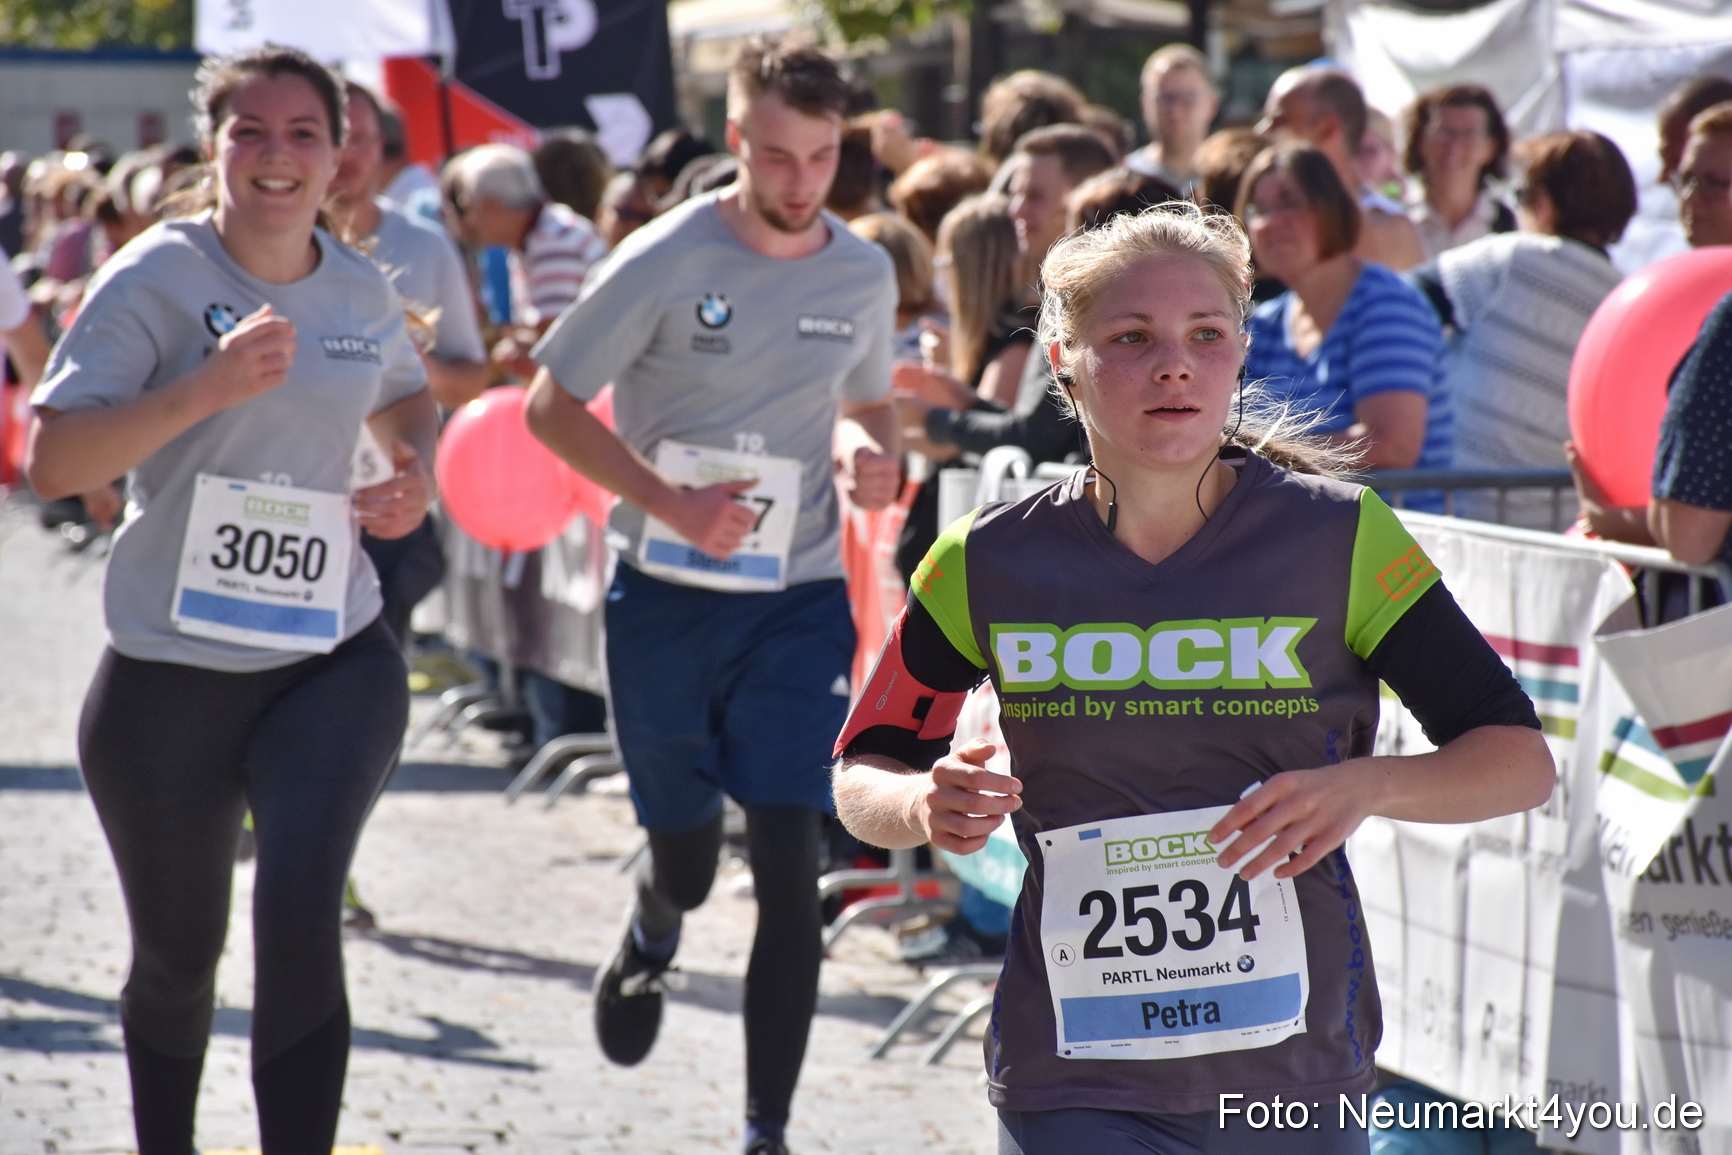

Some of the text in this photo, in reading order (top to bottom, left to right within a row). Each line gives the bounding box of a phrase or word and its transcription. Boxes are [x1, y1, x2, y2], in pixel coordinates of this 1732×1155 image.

[244, 496, 310, 520] BOCK
[211, 523, 327, 583] 3050
[994, 622, 1310, 688] BOCK
[1002, 695, 1320, 722] inspired by smart concepts
[1105, 831, 1216, 866] BOCK
[1106, 857, 1219, 875] inspired by smart concepts
[1079, 873, 1260, 959] 2534
[1059, 949, 1069, 961] A
[1102, 961, 1231, 985] PARTL Neumarkt
[1141, 999, 1221, 1030] Petra
